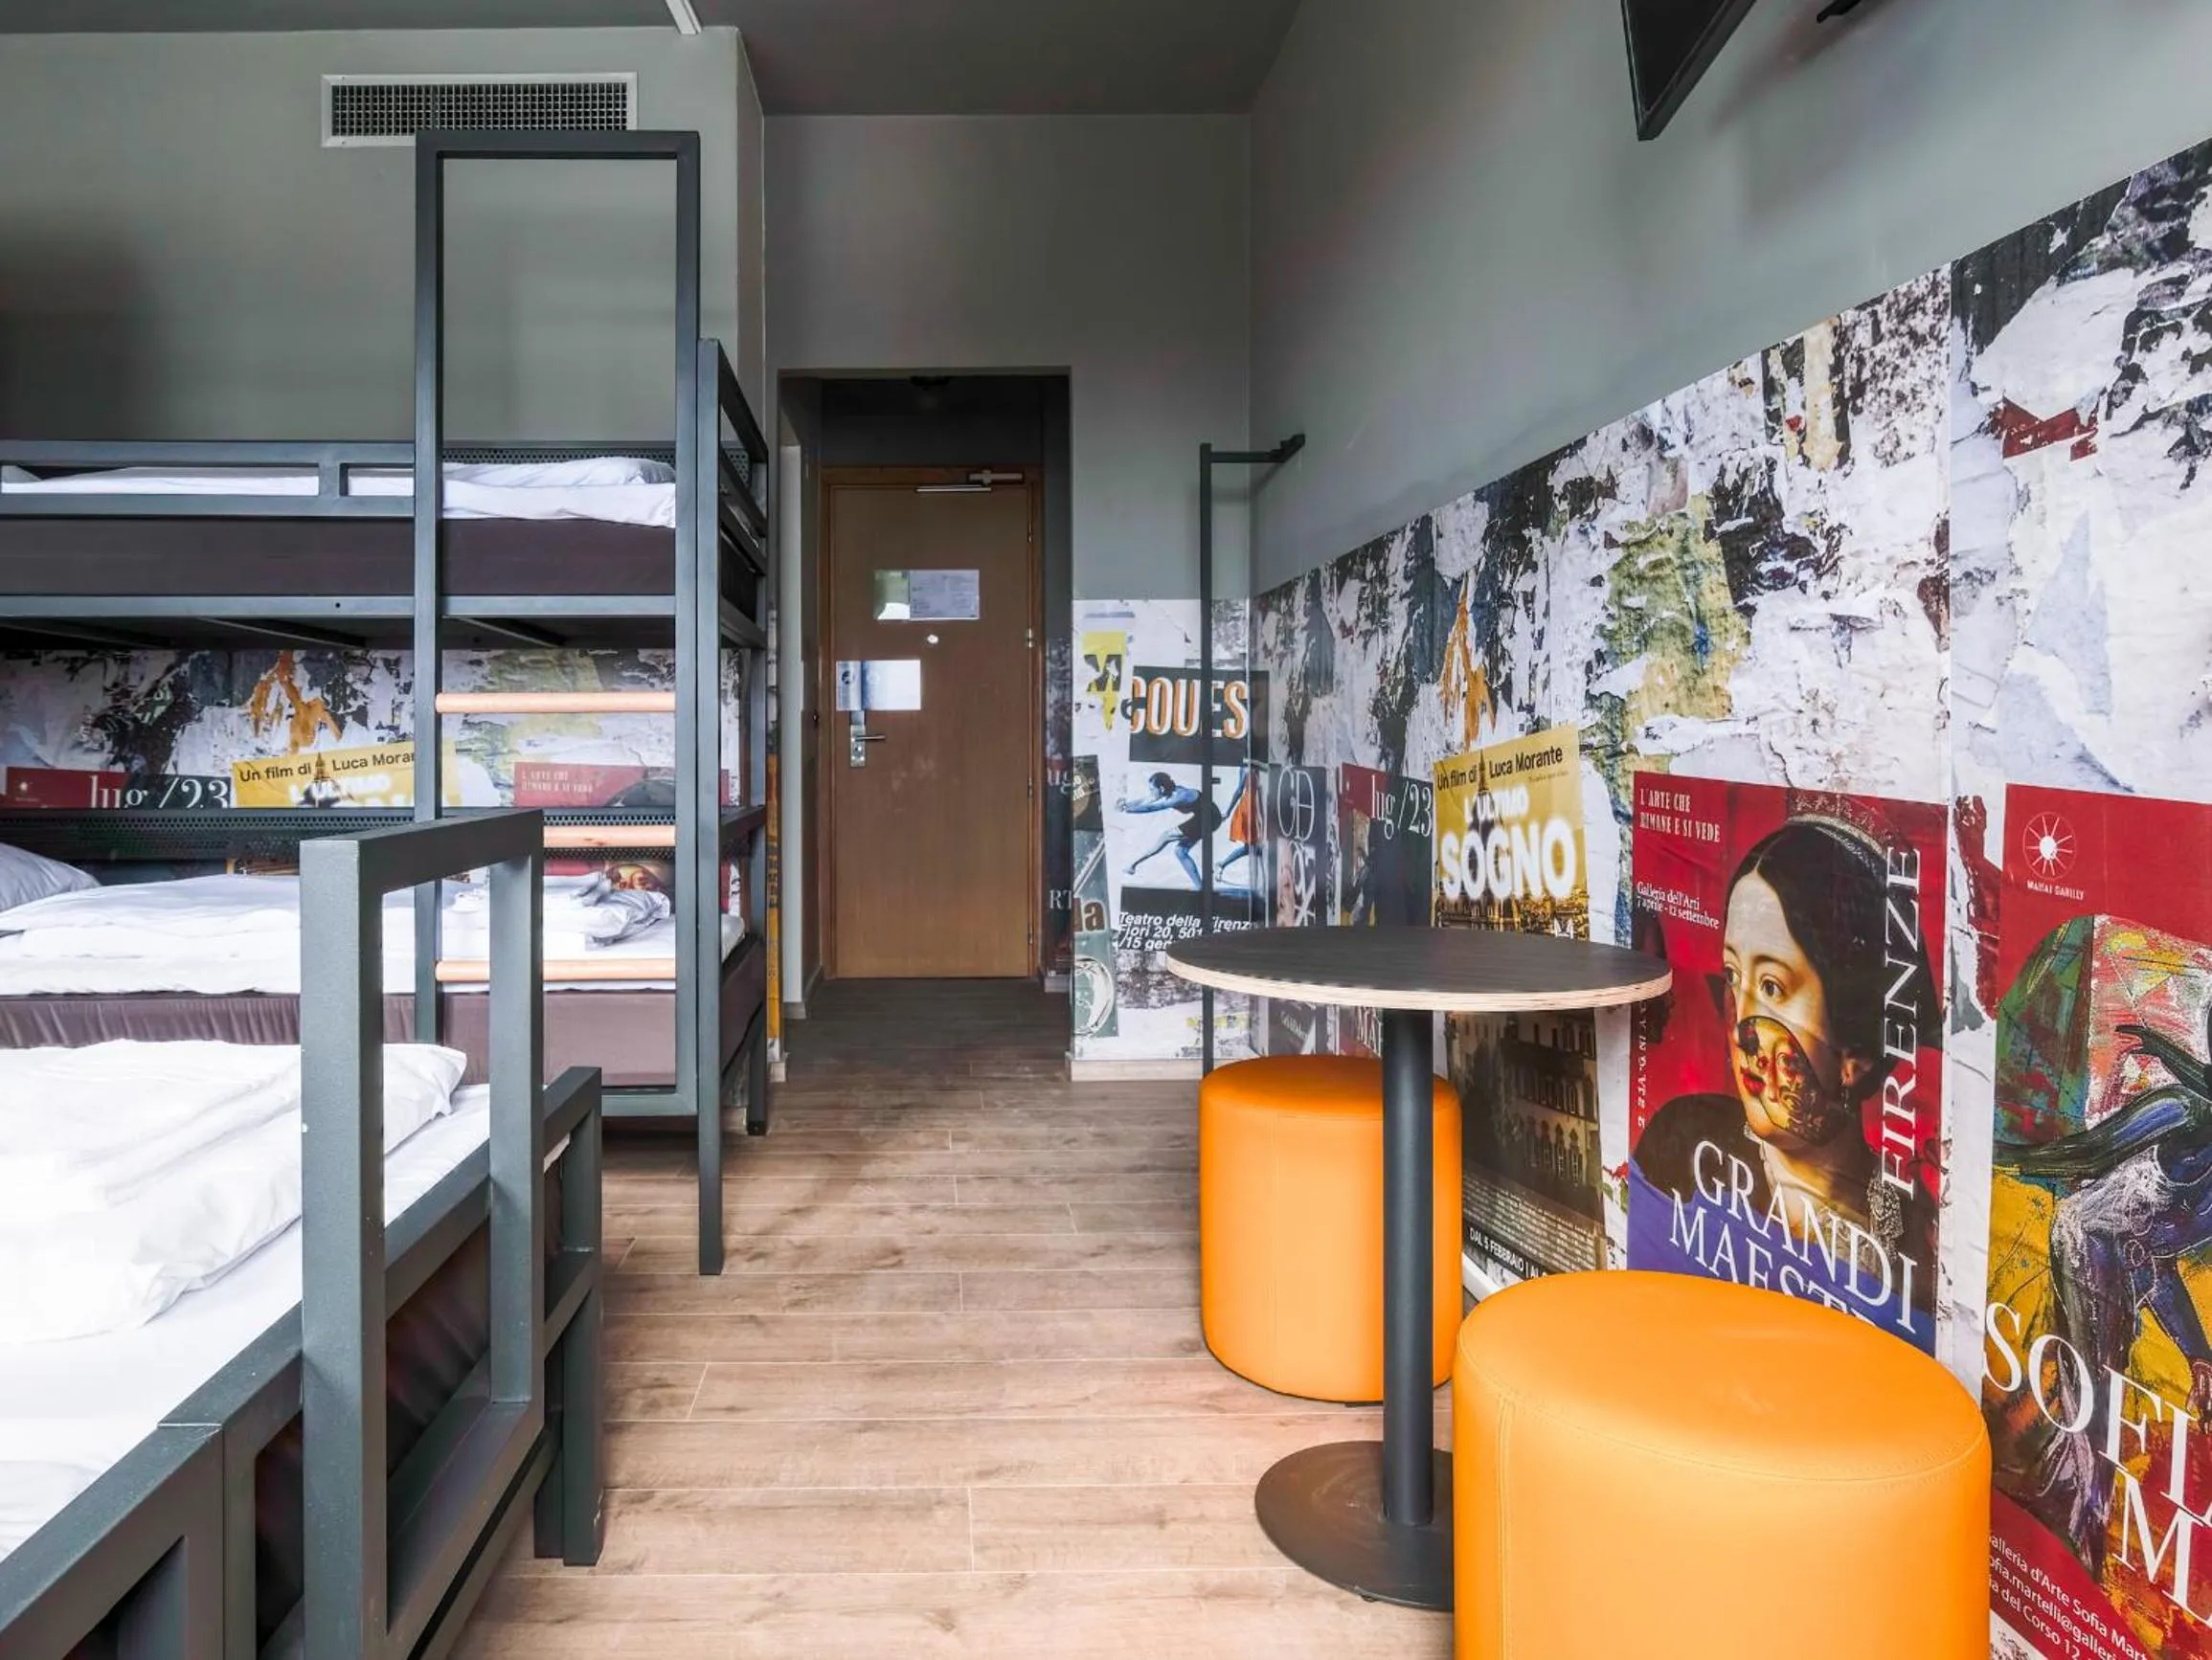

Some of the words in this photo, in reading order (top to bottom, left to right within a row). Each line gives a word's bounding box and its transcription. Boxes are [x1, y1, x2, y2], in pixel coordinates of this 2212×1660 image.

[239, 770, 260, 783] Un
[265, 765, 293, 780] film
[298, 762, 311, 775] di
[332, 759, 369, 772] Luca
[372, 751, 415, 766] Mora
[1436, 774, 1449, 791] Un
[1450, 769, 1467, 787] film
[1468, 764, 1478, 783] di
[1489, 759, 1513, 778] Luca
[1516, 746, 1563, 773] Morante
[1639, 788, 1670, 810] L'ARTE
[1674, 793, 1691, 813] CHE
[1440, 817, 1576, 901] SOGNO
[1675, 818, 1681, 835] E
[1682, 819, 1692, 838] SI
[1696, 820, 1720, 842] VEDE
[1119, 911, 1162, 927] Teatro
[1166, 914, 1201, 928] della
[1212, 916, 1255, 931] irenz
[1636, 881, 1666, 902] Galleria
[1881, 846, 1921, 1201] FIRENZE
[1693, 1140, 1918, 1334] GRANDI
[1983, 1301, 2208, 1527] SOFI
[2111, 1465, 2212, 1626] M
[1990, 1534, 2028, 1571] alleria
[2030, 1566, 2070, 1606] d'Arte
[2072, 1598, 2108, 1639] Sofia
[2110, 1628, 2148, 1660] Mart
[1990, 1555, 2117, 1660] ofia.martelli@galleri
[2001, 1588, 2020, 1611] del
[2022, 1605, 2061, 1646] Corso
